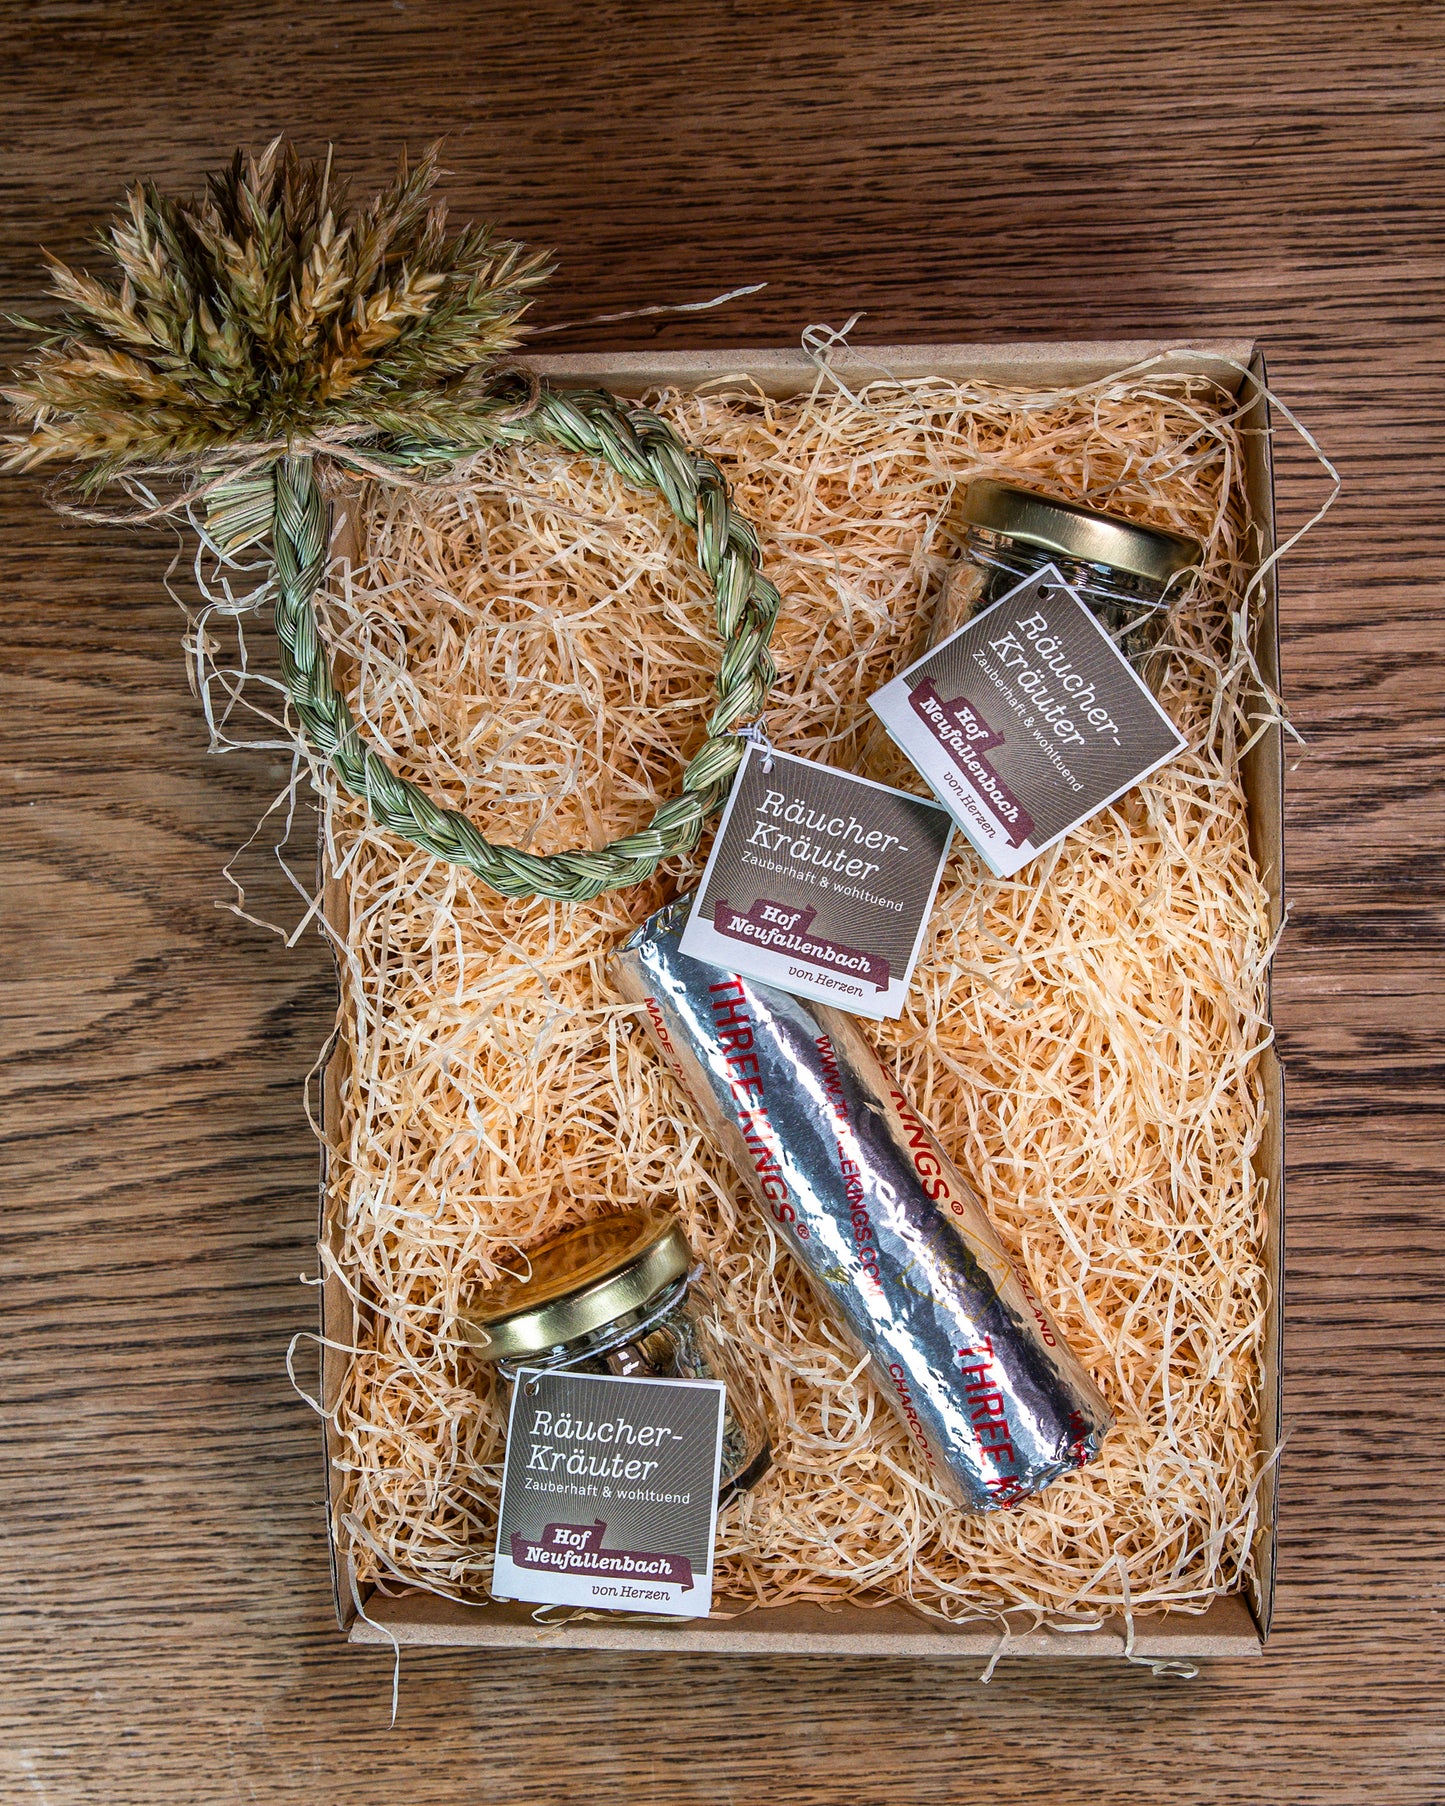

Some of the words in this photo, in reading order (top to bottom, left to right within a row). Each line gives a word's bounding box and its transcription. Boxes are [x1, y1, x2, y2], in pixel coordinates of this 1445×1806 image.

[988, 631, 1085, 747] Kräuter
[1015, 611, 1121, 746] Räucher-
[953, 706, 990, 741] Hof
[972, 649, 1027, 716] Zauberhaft
[1023, 716, 1034, 728] &
[1032, 728, 1084, 793] wohltuend
[919, 697, 1020, 823] Neufallenbach
[756, 789, 909, 852] Räucher-
[943, 772, 964, 796] von
[959, 793, 996, 839] Herzen
[746, 820, 880, 880] Kräuter
[741, 850, 816, 884] Zauberhaft
[819, 876, 830, 888] &
[833, 882, 904, 912] wohltuend
[727, 915, 871, 973] Neufallenbach
[760, 905, 800, 930] Hof
[788, 965, 814, 983] von
[815, 973, 864, 998] Herzen
[644, 997, 675, 1055] MADE
[708, 973, 764, 1100] THREE
[529, 1409, 683, 1447] Räucher-
[958, 1335, 1016, 1466] THREE
[524, 1478, 598, 1497] Zauberhaft
[602, 1486, 612, 1498] &
[617, 1489, 690, 1504] wohltuend
[526, 1444, 658, 1480] Kräuter
[524, 1546, 673, 1575] Neufallenbach
[552, 1528, 592, 1550] Hof
[591, 1584, 618, 1597] von
[619, 1585, 670, 1601] Herzen
